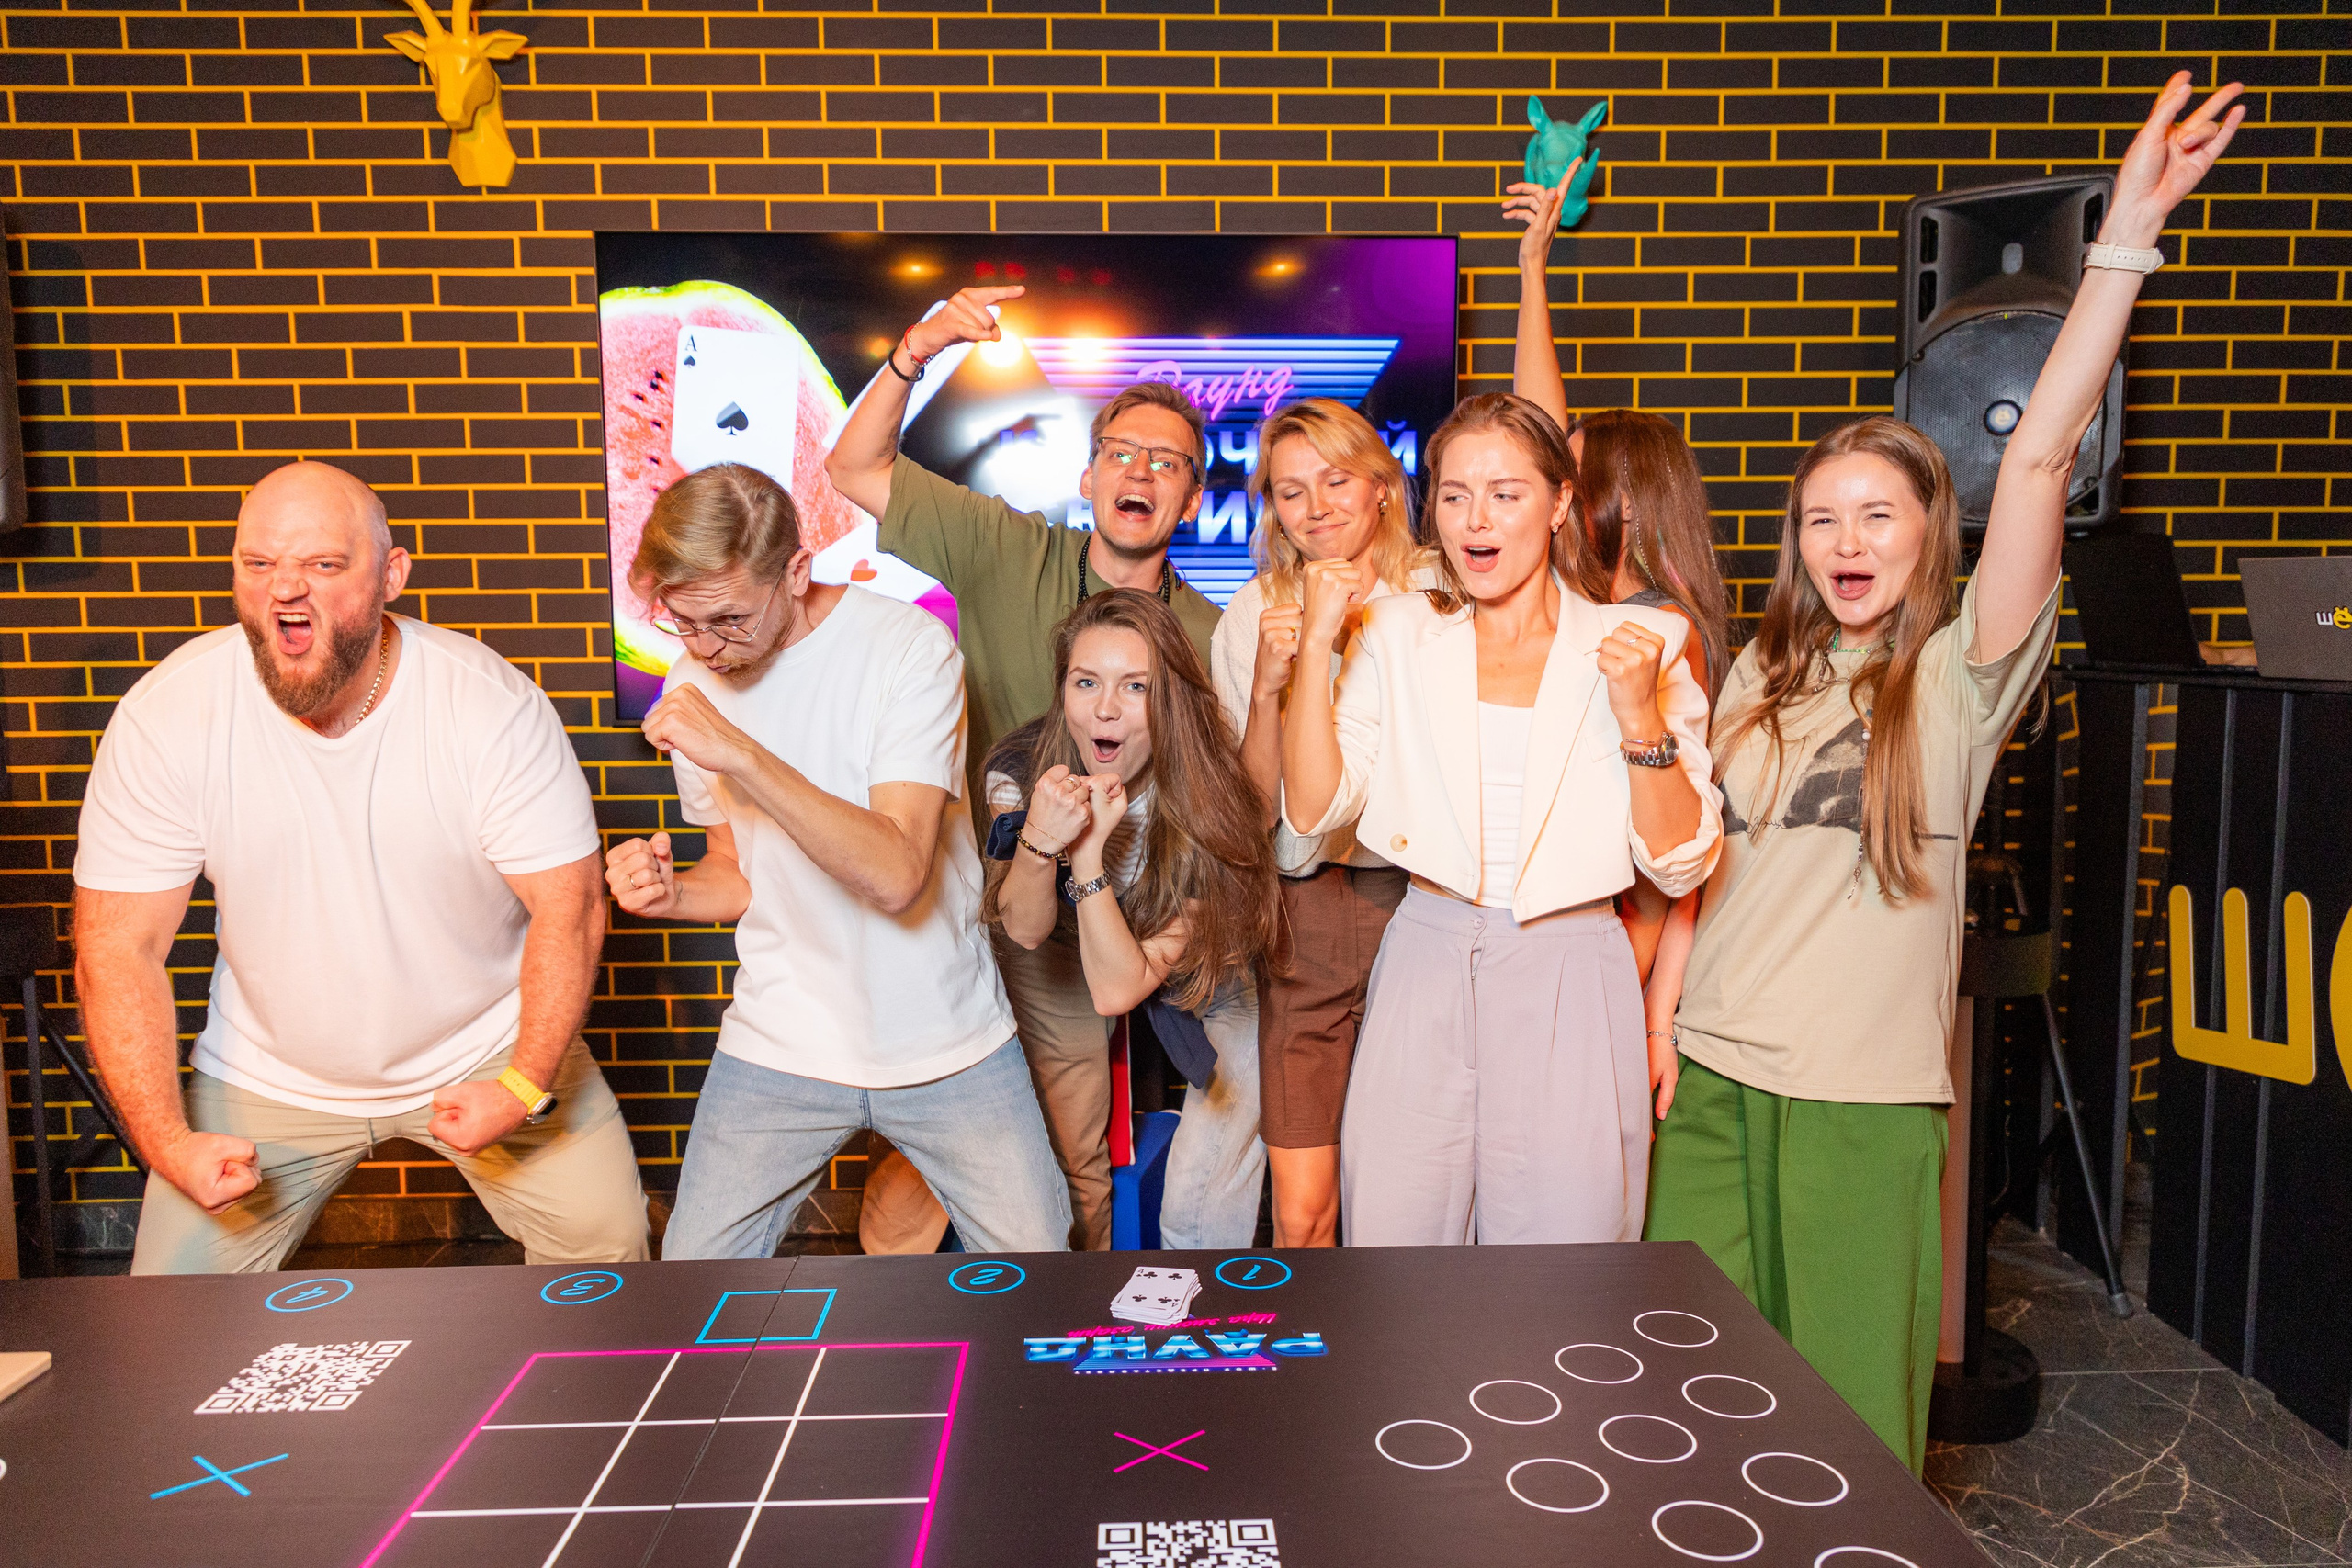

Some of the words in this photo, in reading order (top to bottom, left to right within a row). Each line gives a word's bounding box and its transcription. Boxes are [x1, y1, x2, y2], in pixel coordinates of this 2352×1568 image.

[684, 334, 698, 353] A
[969, 1268, 1004, 1286] 2
[1242, 1264, 1261, 1280] 1
[285, 1286, 329, 1304] 4
[560, 1278, 606, 1296] 3
[1023, 1331, 1326, 1361] РАУНД
